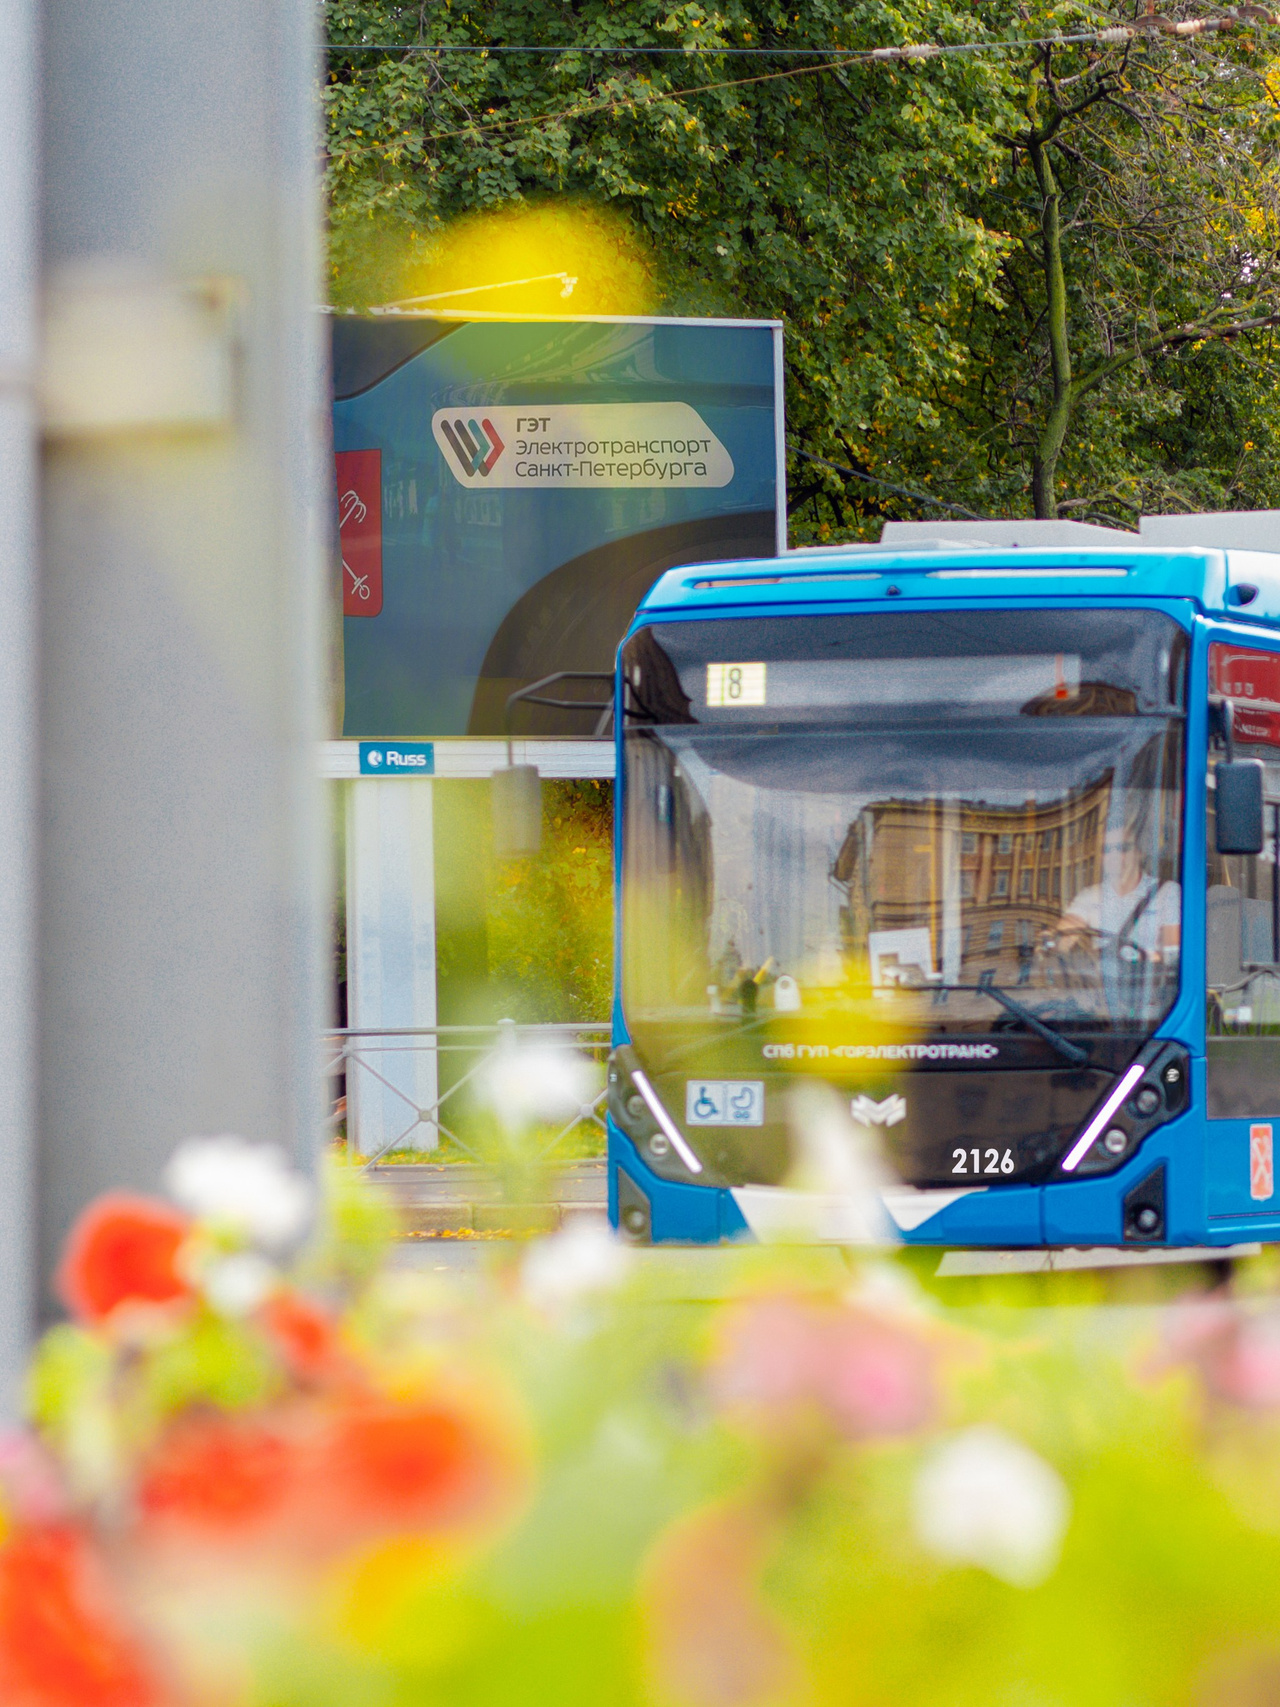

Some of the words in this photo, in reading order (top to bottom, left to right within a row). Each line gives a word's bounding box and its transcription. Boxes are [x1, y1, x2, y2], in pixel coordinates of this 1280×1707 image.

[516, 417, 551, 433] ГЭТ
[515, 439, 711, 457] Электротранспорт
[515, 459, 707, 479] Санкт-Петербурга
[729, 667, 742, 699] 8
[386, 750, 427, 767] Russ
[797, 1044, 829, 1058] ГУП
[951, 1148, 1015, 1174] 2126
